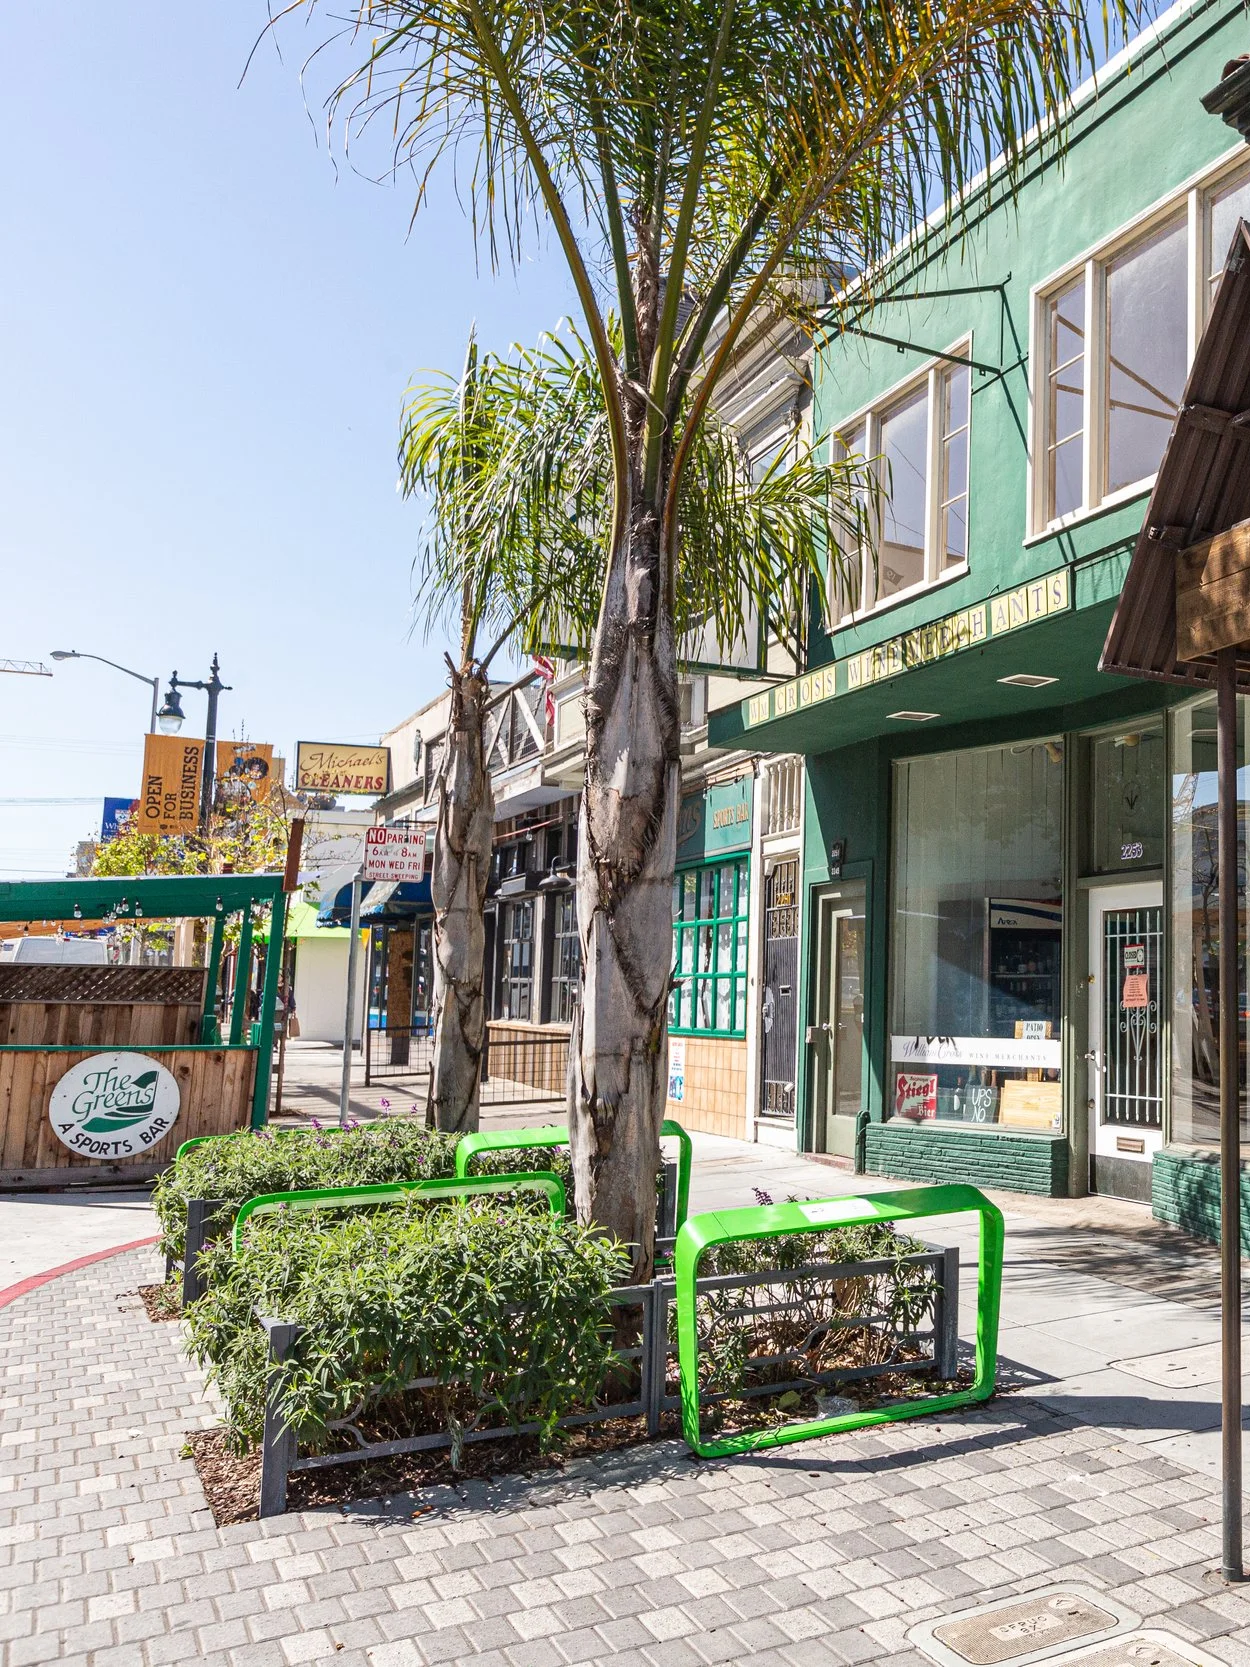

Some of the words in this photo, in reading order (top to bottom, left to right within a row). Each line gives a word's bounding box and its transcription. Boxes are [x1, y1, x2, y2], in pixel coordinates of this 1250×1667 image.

[776, 672, 834, 713] CROSS
[849, 643, 901, 687] WINE
[906, 579, 1062, 664] MERCHANTS
[300, 751, 385, 772] Michael's
[179, 746, 199, 820] BUSINESS
[301, 772, 384, 790] CLEANERS
[145, 775, 163, 819] OPEN
[163, 792, 177, 820] FOR
[713, 805, 734, 829] SPORTS
[736, 802, 749, 825] BAR
[368, 829, 386, 844] NO
[368, 859, 386, 869] MON
[388, 860, 405, 870] WED
[408, 861, 421, 871] FRI
[83, 1067, 131, 1092] The
[897, 1075, 935, 1100] Stiegl
[72, 1087, 153, 1123] Greens
[971, 1088, 992, 1107] UPS
[917, 1104, 936, 1117] Bier
[971, 1106, 986, 1122] NO
[58, 1122, 75, 1134] A
[69, 1133, 133, 1155] SPORTS
[139, 1117, 169, 1144] BAR
